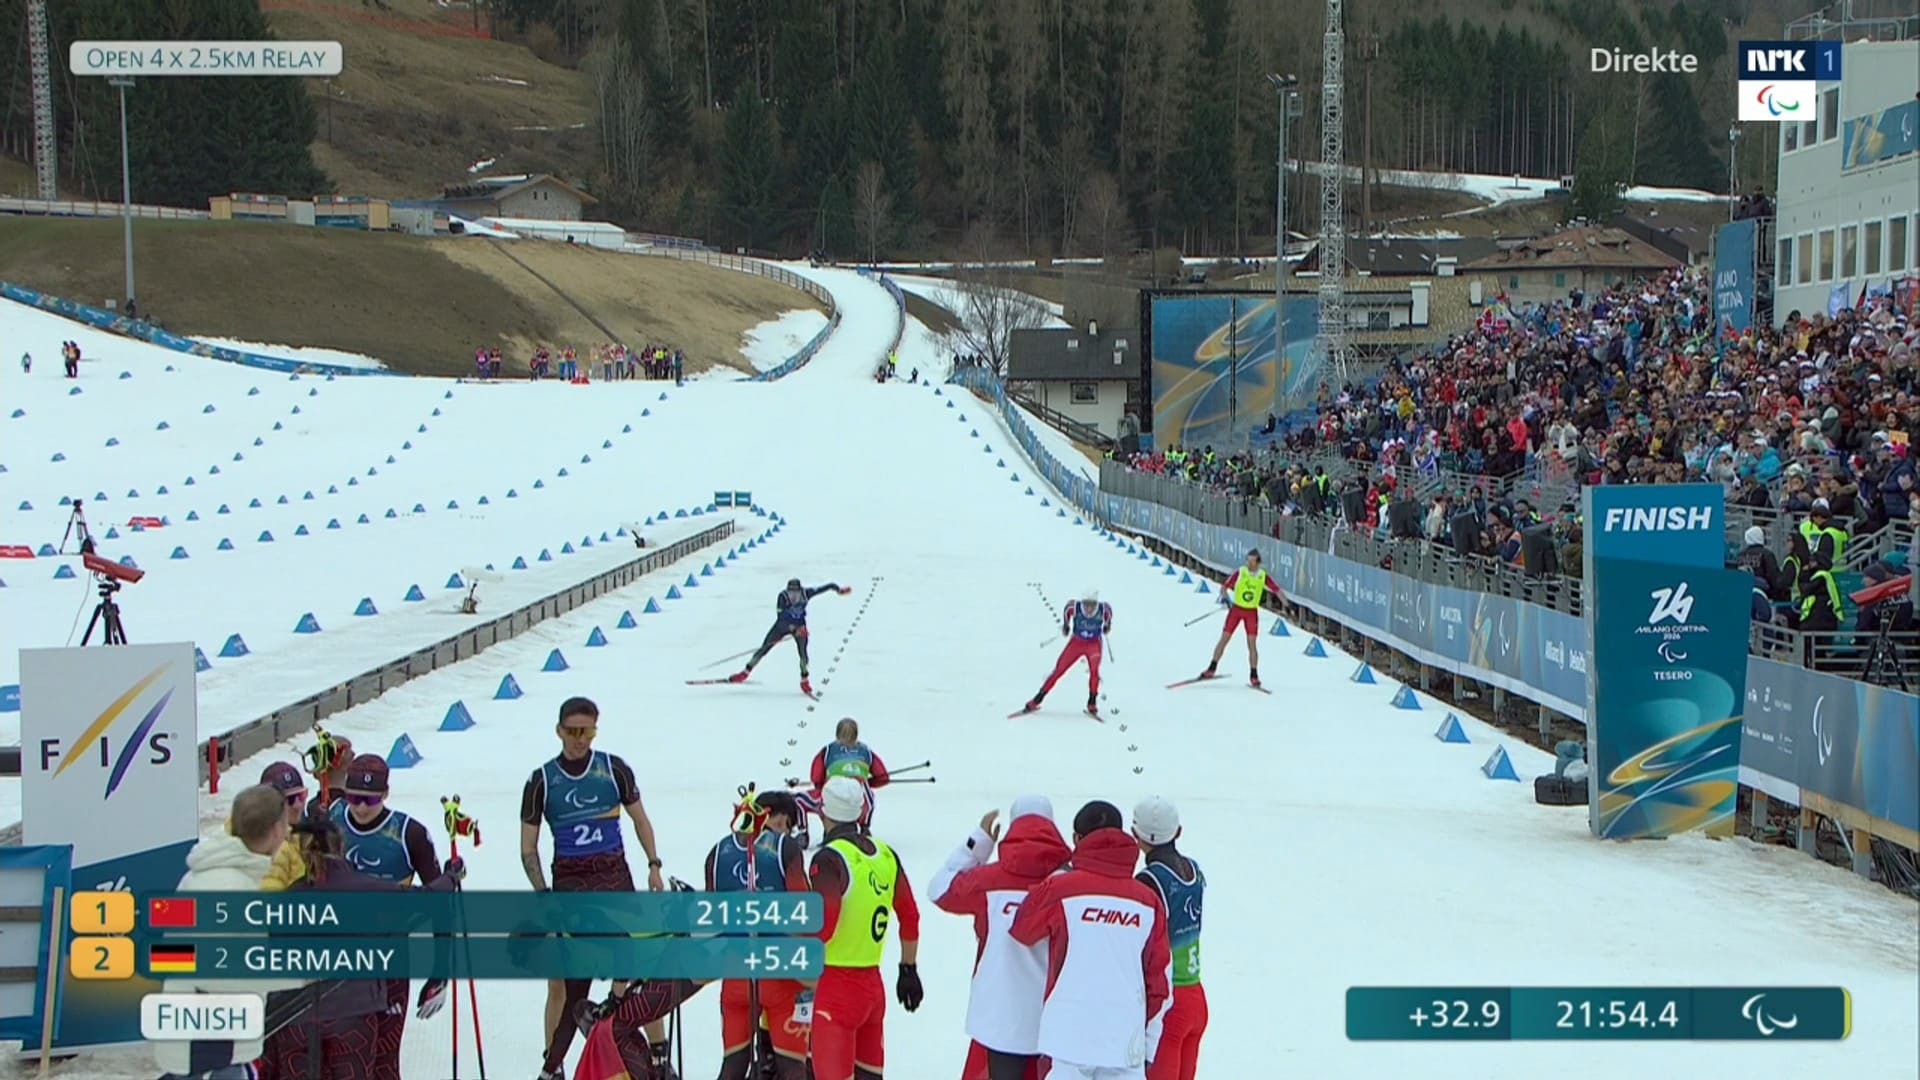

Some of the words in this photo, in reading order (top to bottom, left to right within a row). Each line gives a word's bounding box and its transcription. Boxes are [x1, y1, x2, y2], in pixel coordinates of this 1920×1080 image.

[1604, 506, 1712, 532] FINISH
[1242, 591, 1254, 603] G
[1635, 625, 1671, 634] MILANO
[1672, 624, 1710, 633] CORTINA
[1653, 670, 1693, 681] TESERO
[40, 733, 171, 771] FIS
[574, 825, 603, 845] 24
[871, 905, 889, 943] G
[1081, 907, 1142, 928] CHINA
